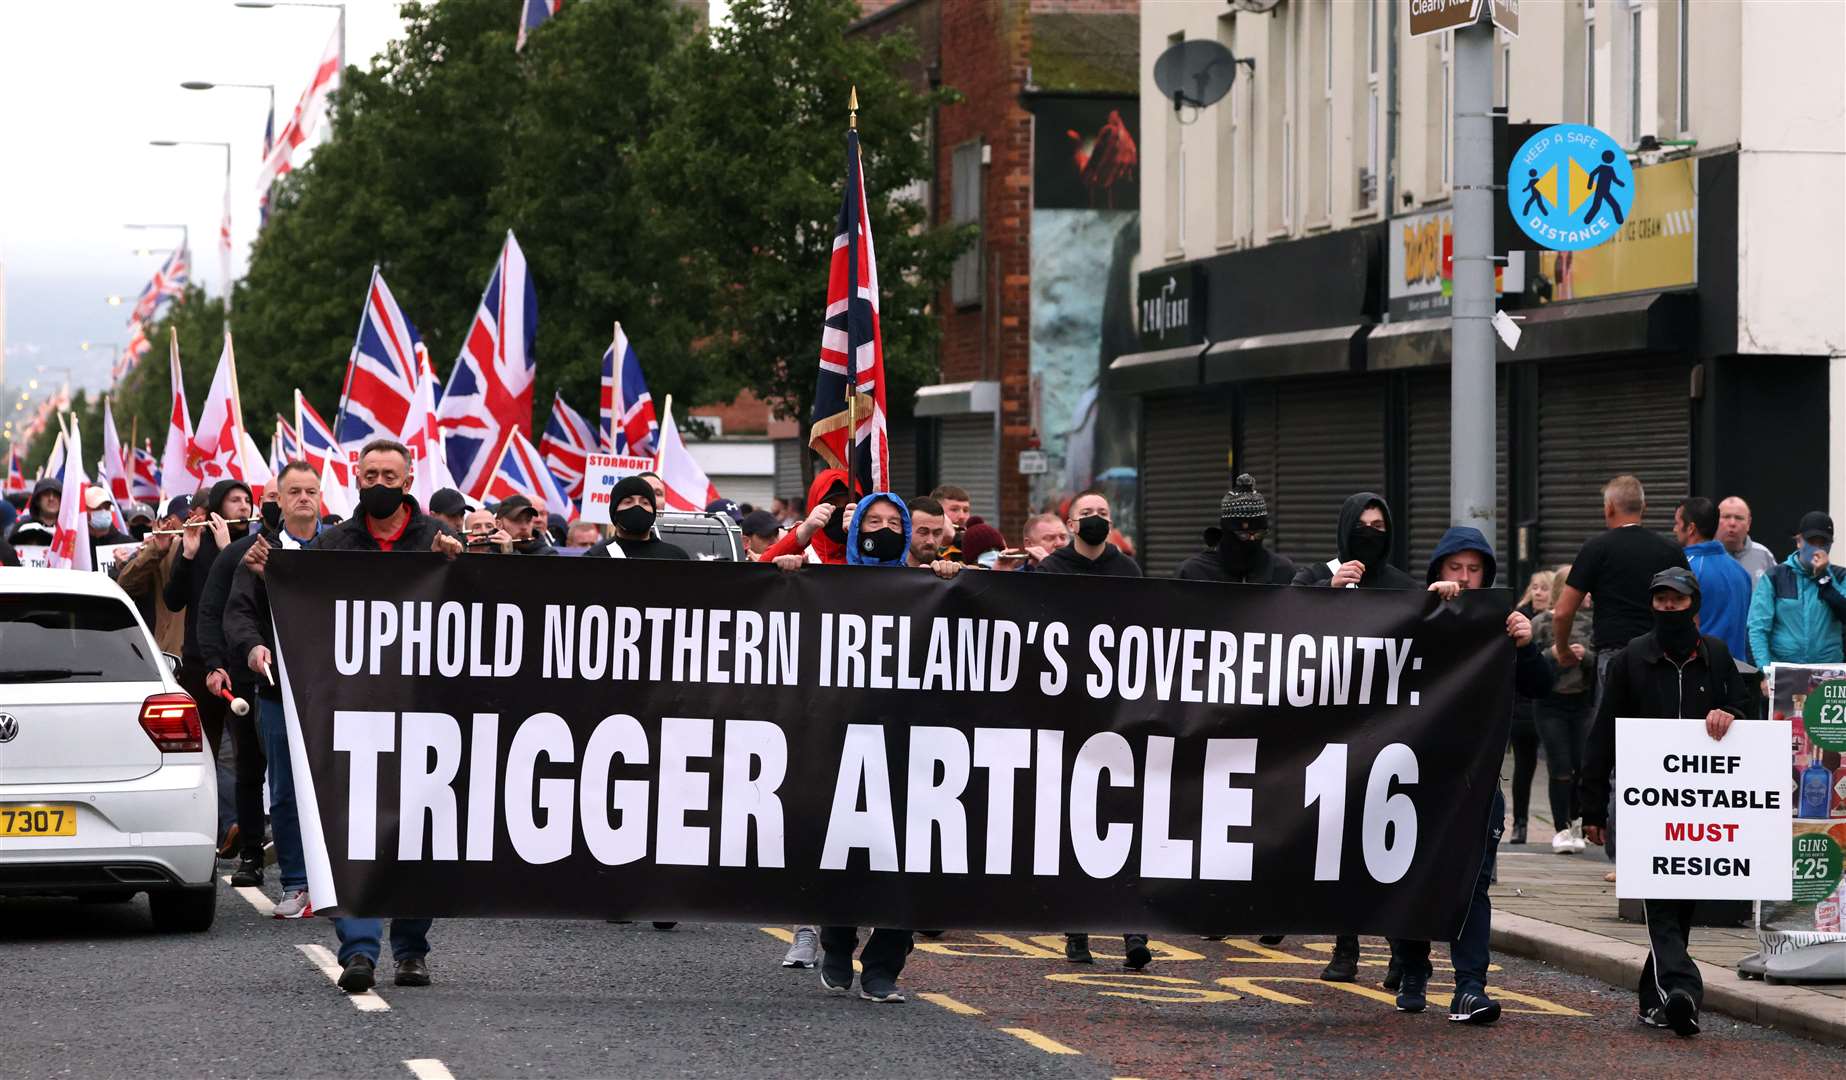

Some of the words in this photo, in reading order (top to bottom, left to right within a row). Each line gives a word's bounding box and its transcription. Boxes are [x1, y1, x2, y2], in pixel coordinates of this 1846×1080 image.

[1554, 133, 1563, 144] A
[1567, 132, 1599, 149] SAFE
[1529, 216, 1610, 243] DISTANCE
[589, 455, 651, 470] STORMONT
[334, 600, 524, 678] UPHOLD
[542, 604, 800, 686] NORTHERN
[819, 613, 1069, 696] IRELAND'S
[1087, 623, 1423, 707] SOVEREIGNTY:
[1663, 754, 1741, 774] CHIEF
[333, 711, 788, 865] TRIGGER
[819, 723, 1258, 879] ARTICLE
[1304, 742, 1420, 884] 16
[1623, 787, 1781, 809] CONSTABLE
[2, 810, 64, 833] 7307
[1665, 822, 1739, 842] MUST
[1798, 839, 1828, 852] GINS
[1652, 856, 1750, 877] RESIGN
[1792, 858, 1829, 879] £25
